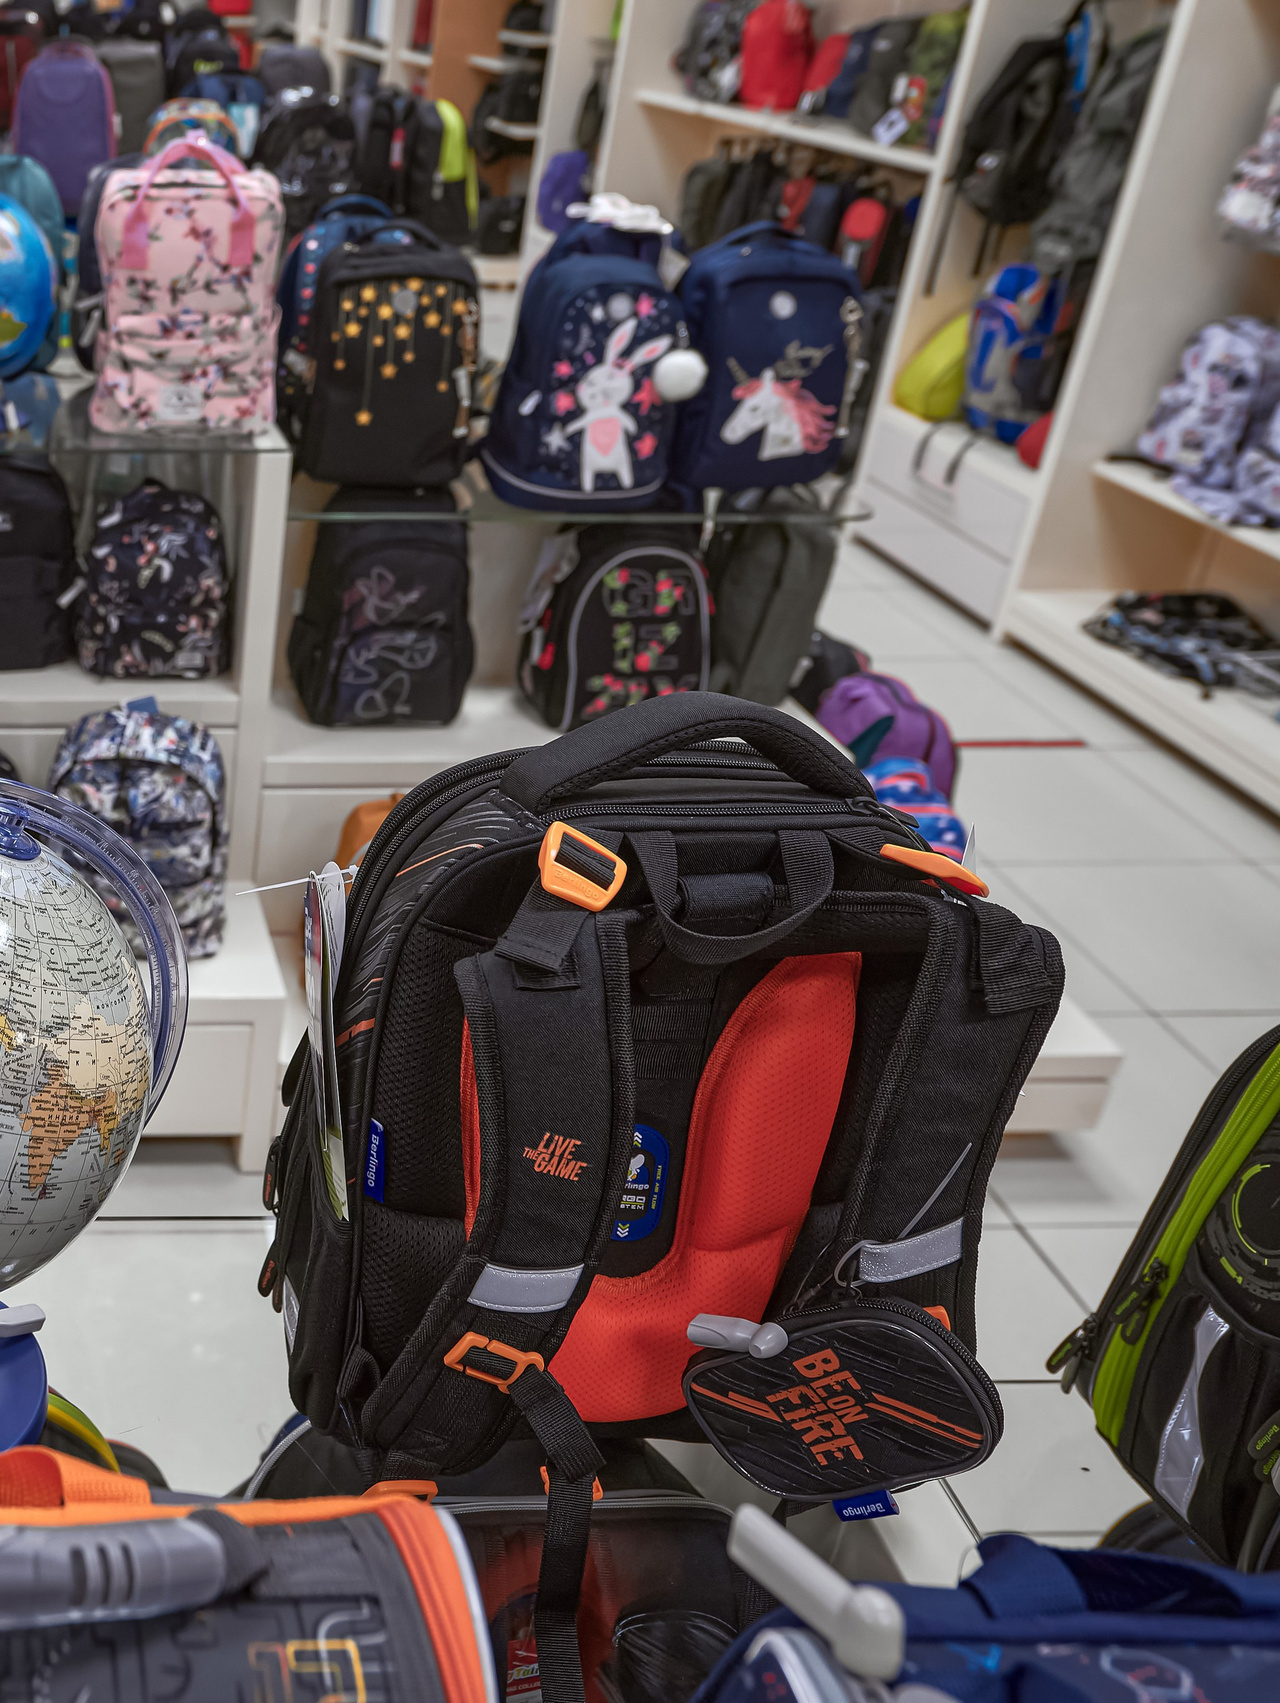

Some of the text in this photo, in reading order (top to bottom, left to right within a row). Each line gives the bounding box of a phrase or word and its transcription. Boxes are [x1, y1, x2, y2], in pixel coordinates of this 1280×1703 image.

[367, 1133, 380, 1188] Berlingo
[523, 1147, 588, 1183] THE GAME
[537, 1132, 582, 1160] LIVE
[792, 1348, 869, 1423] BE ON
[766, 1384, 864, 1466] FIRE
[842, 1502, 886, 1517] Berlingo
